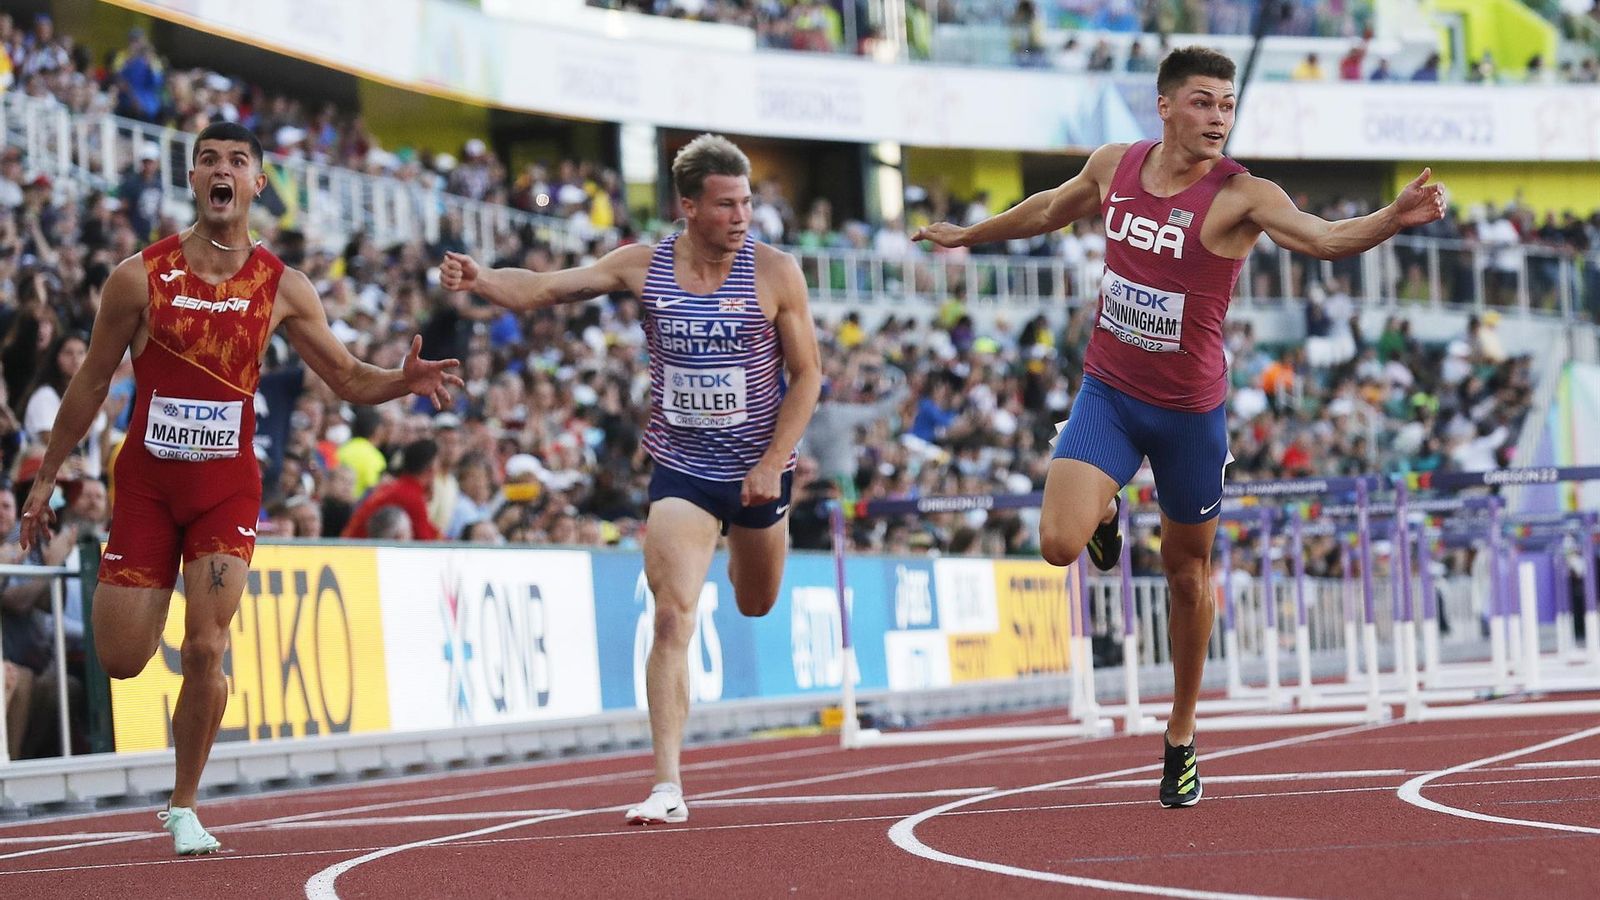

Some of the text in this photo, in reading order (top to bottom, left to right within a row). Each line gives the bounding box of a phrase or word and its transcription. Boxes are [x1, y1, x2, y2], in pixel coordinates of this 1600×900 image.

[1105, 206, 1186, 259] USA
[171, 295, 251, 313] ESPAÑA
[1122, 284, 1170, 312] TDK
[1105, 295, 1177, 336] CUNNINGHAM
[658, 318, 743, 337] GREAT
[661, 337, 742, 353] BRITAIN
[1109, 325, 1163, 352] OREGON22
[684, 374, 732, 388] TDK
[672, 391, 737, 411] ZELLER
[178, 404, 230, 421] TDK
[675, 415, 733, 427] OREGON22
[152, 422, 236, 446] MARTÍNEZ
[481, 582, 553, 713] QNB
